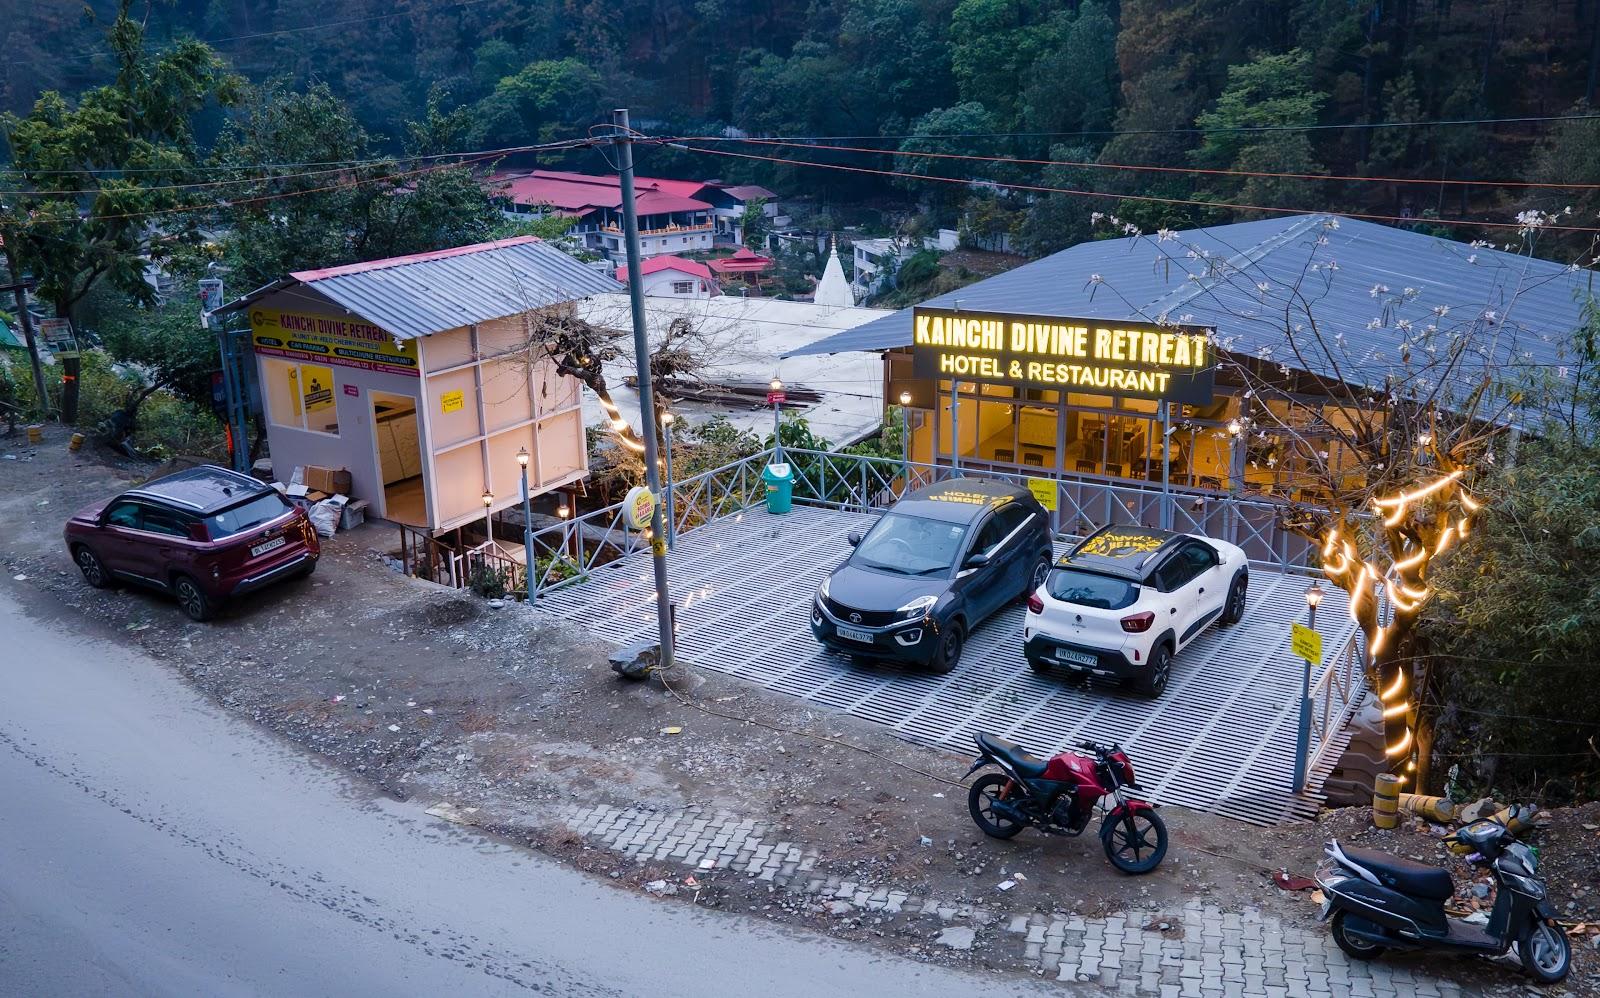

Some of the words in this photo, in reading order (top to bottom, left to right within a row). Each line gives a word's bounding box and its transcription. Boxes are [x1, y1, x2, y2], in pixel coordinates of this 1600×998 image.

[281, 314, 316, 332] KAINCHI
[318, 319, 347, 337] DIVINE
[349, 323, 388, 342] RETREAT
[916, 315, 1004, 350] KAINCHI
[1010, 322, 1088, 356] DIVINE
[1094, 328, 1207, 367] RETREAT
[261, 338, 278, 346] HOTEL
[303, 344, 327, 352] PARKING
[374, 354, 412, 365] RESTAURANT
[941, 354, 1004, 377] HOTEL
[1009, 360, 1023, 379] &
[1028, 361, 1170, 392] RESTAURANT
